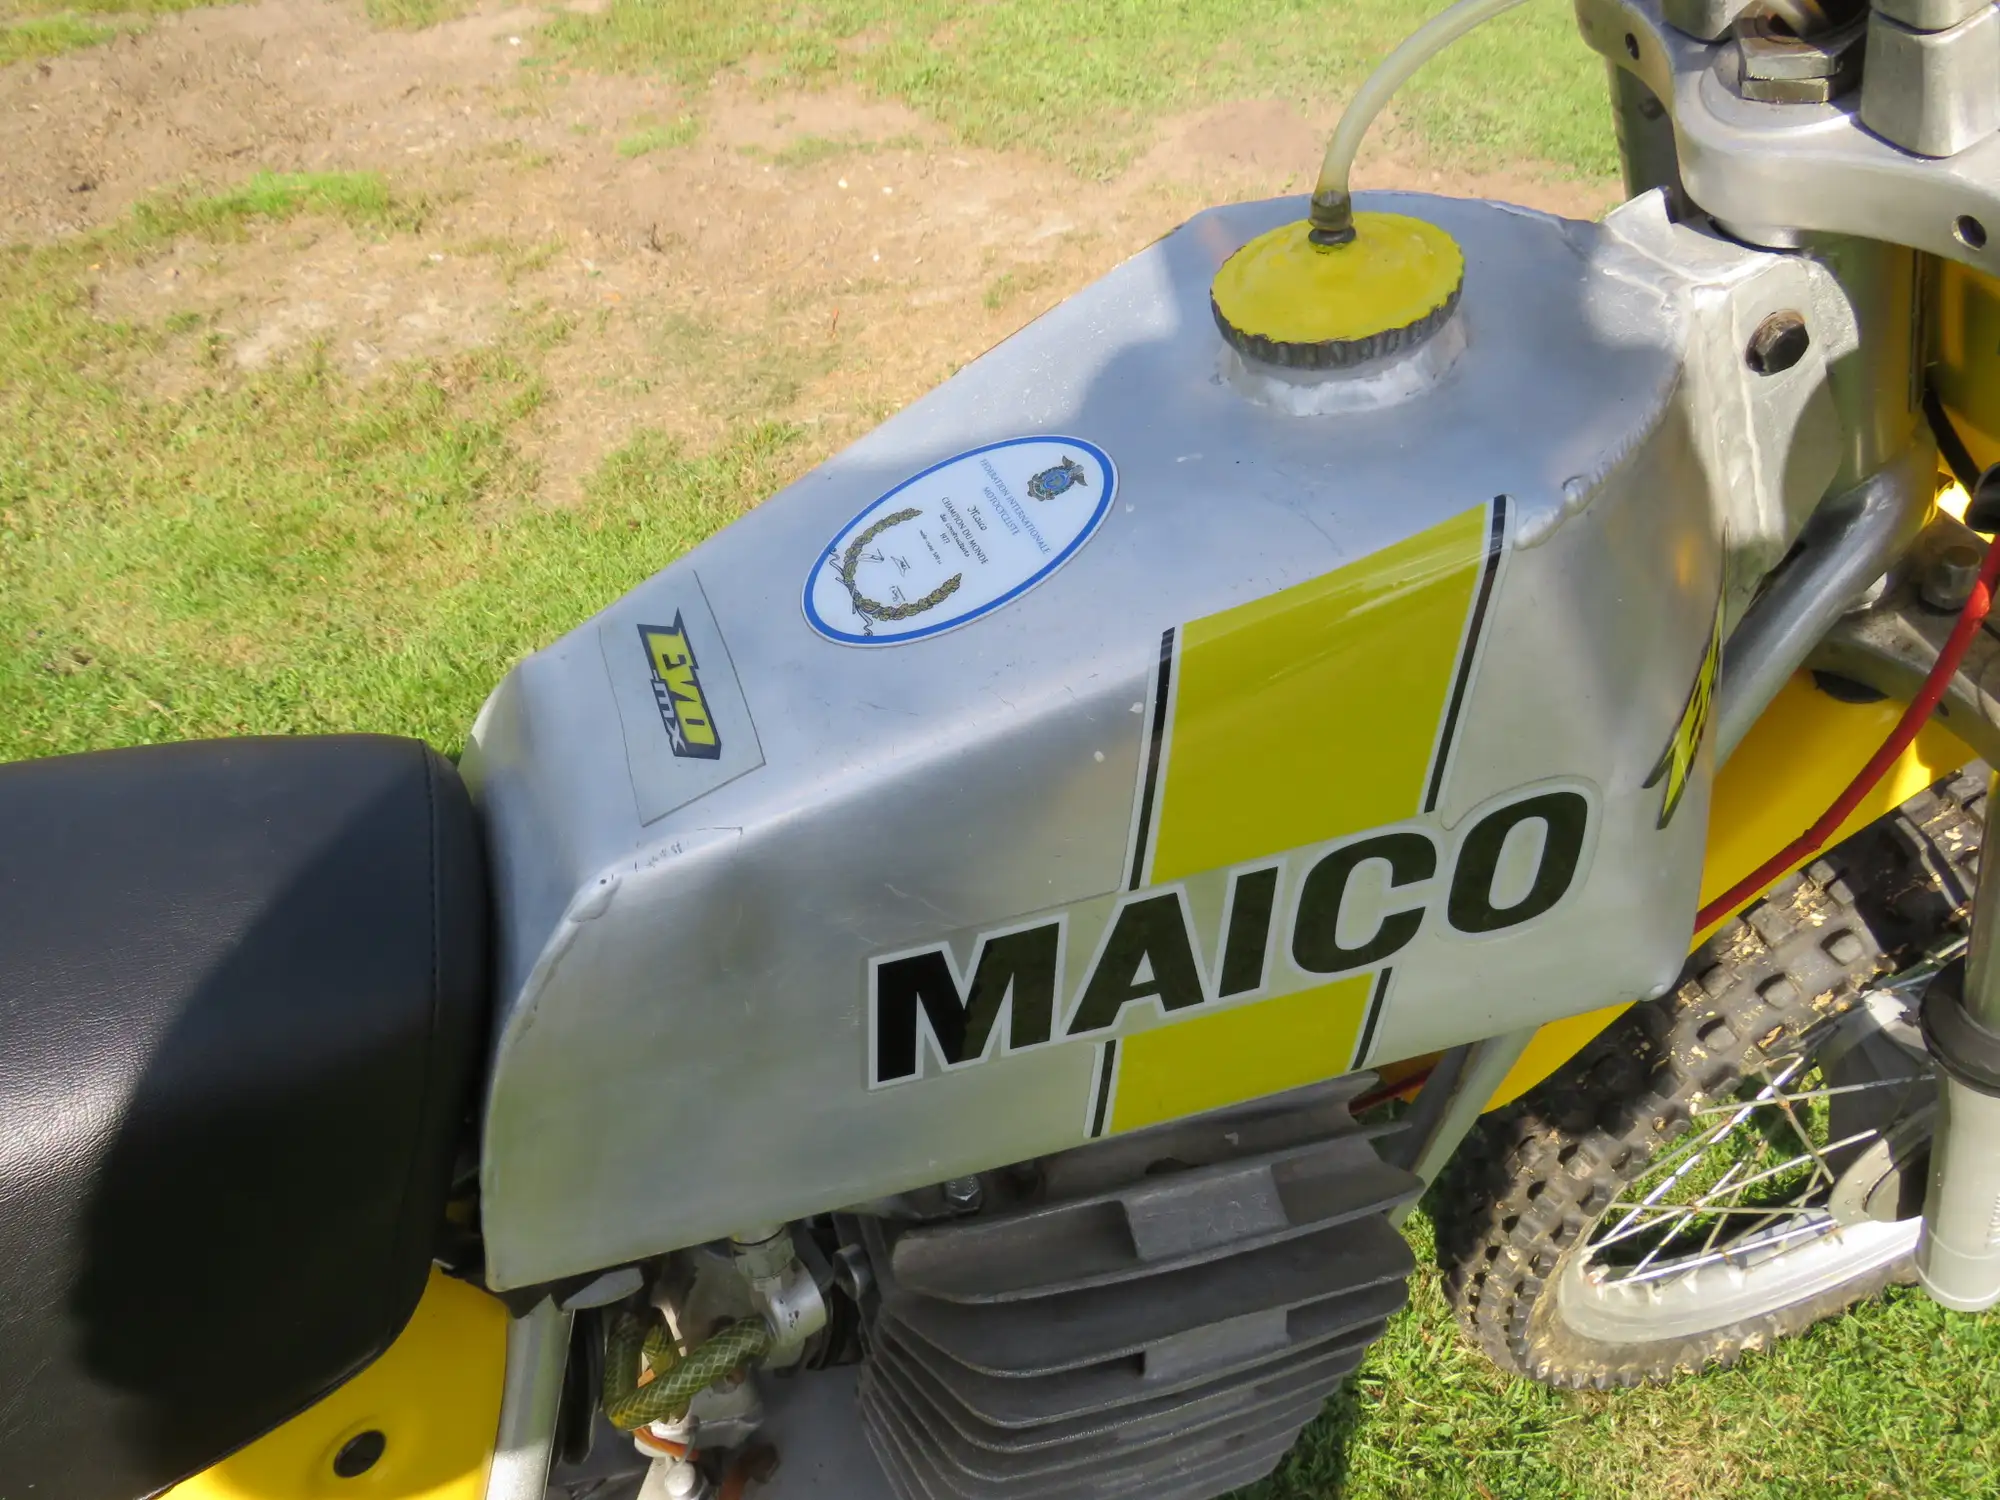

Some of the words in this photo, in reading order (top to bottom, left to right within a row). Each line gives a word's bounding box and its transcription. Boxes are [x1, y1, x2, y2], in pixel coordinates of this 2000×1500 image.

[941, 496, 966, 530] CHAMPION
[962, 527, 974, 541] DU
[968, 539, 989, 564] MONDE
[967, 504, 987, 531] Maico
[980, 458, 1010, 497] FEDERATION
[1006, 494, 1051, 555] INTERNATIONALE
[983, 486, 1020, 536] MOTOCYCLISTE
[875, 790, 1589, 1084] MAICO
